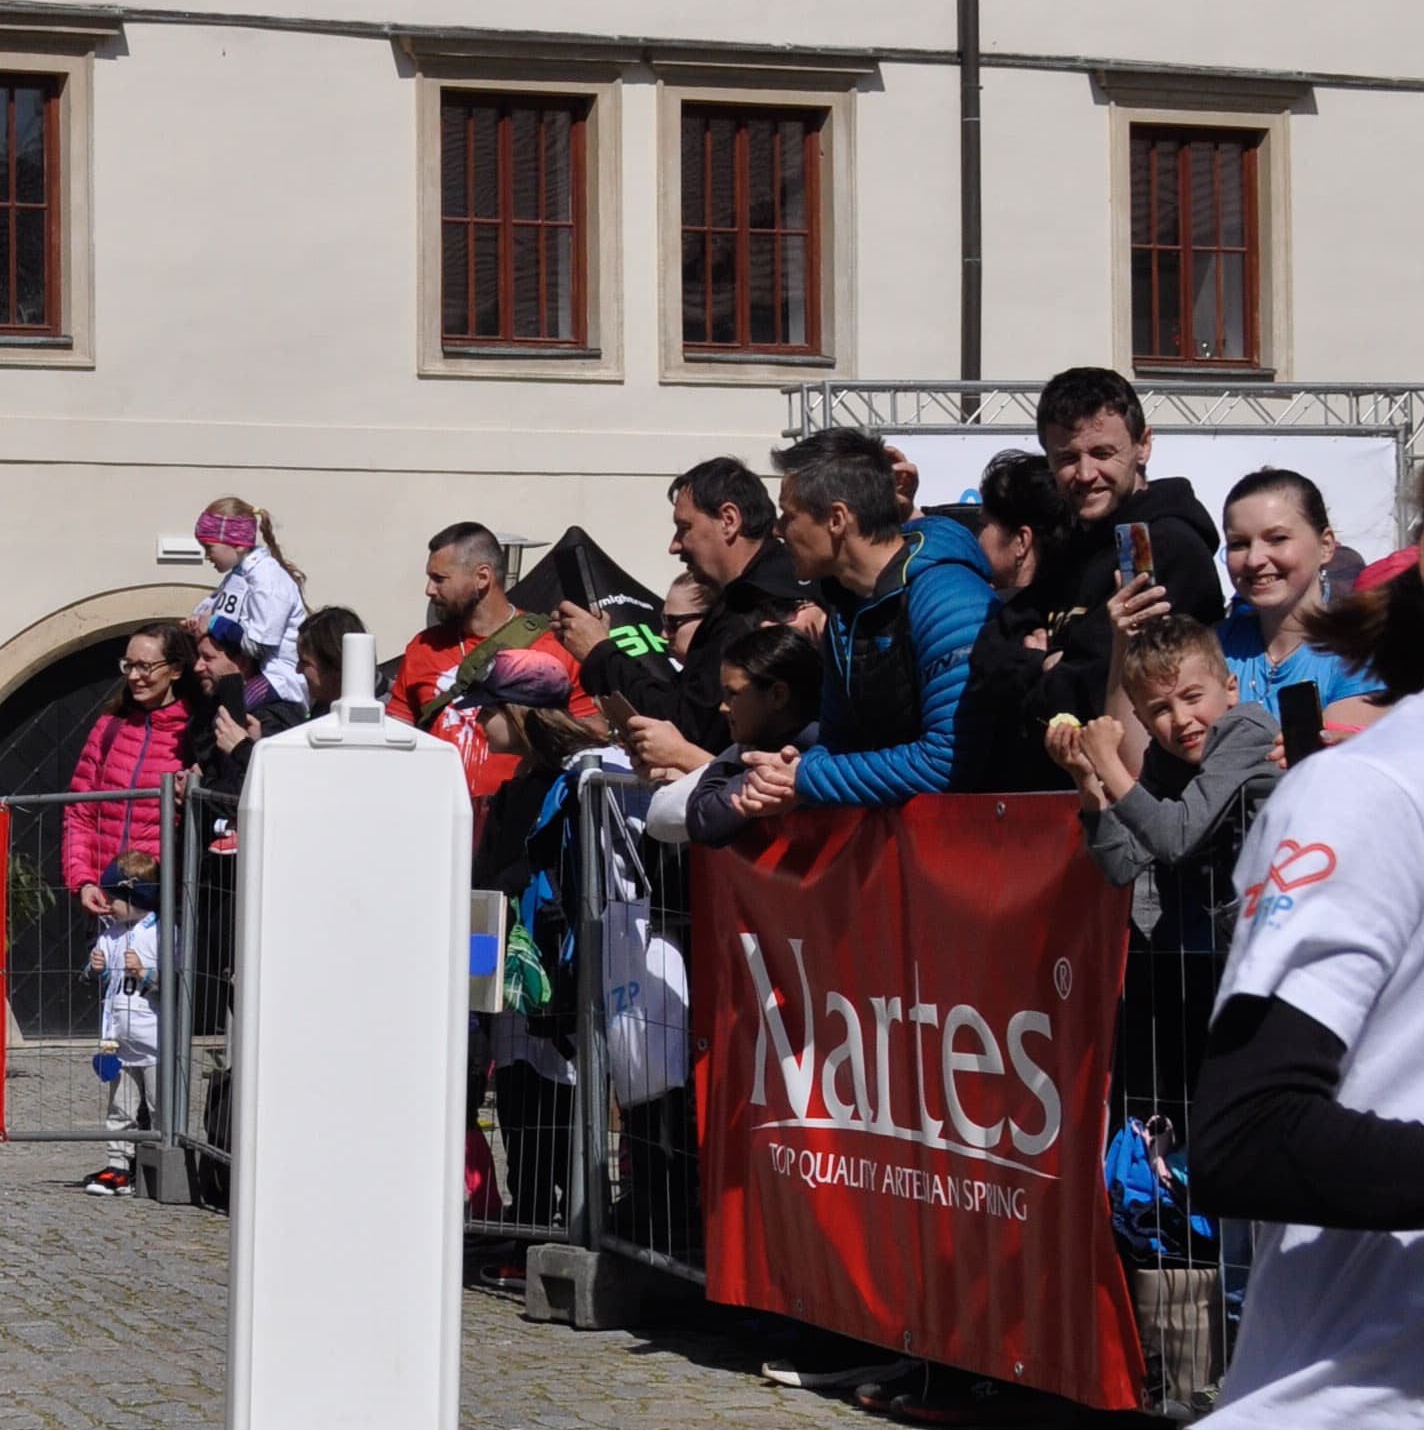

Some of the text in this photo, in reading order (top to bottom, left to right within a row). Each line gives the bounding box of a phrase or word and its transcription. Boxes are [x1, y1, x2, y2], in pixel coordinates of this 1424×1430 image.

[739, 933, 1062, 1155] Nartes
[769, 1143, 795, 1173] TOP
[799, 1149, 877, 1191] QUALITY
[963, 1181, 1027, 1221] SPRING
